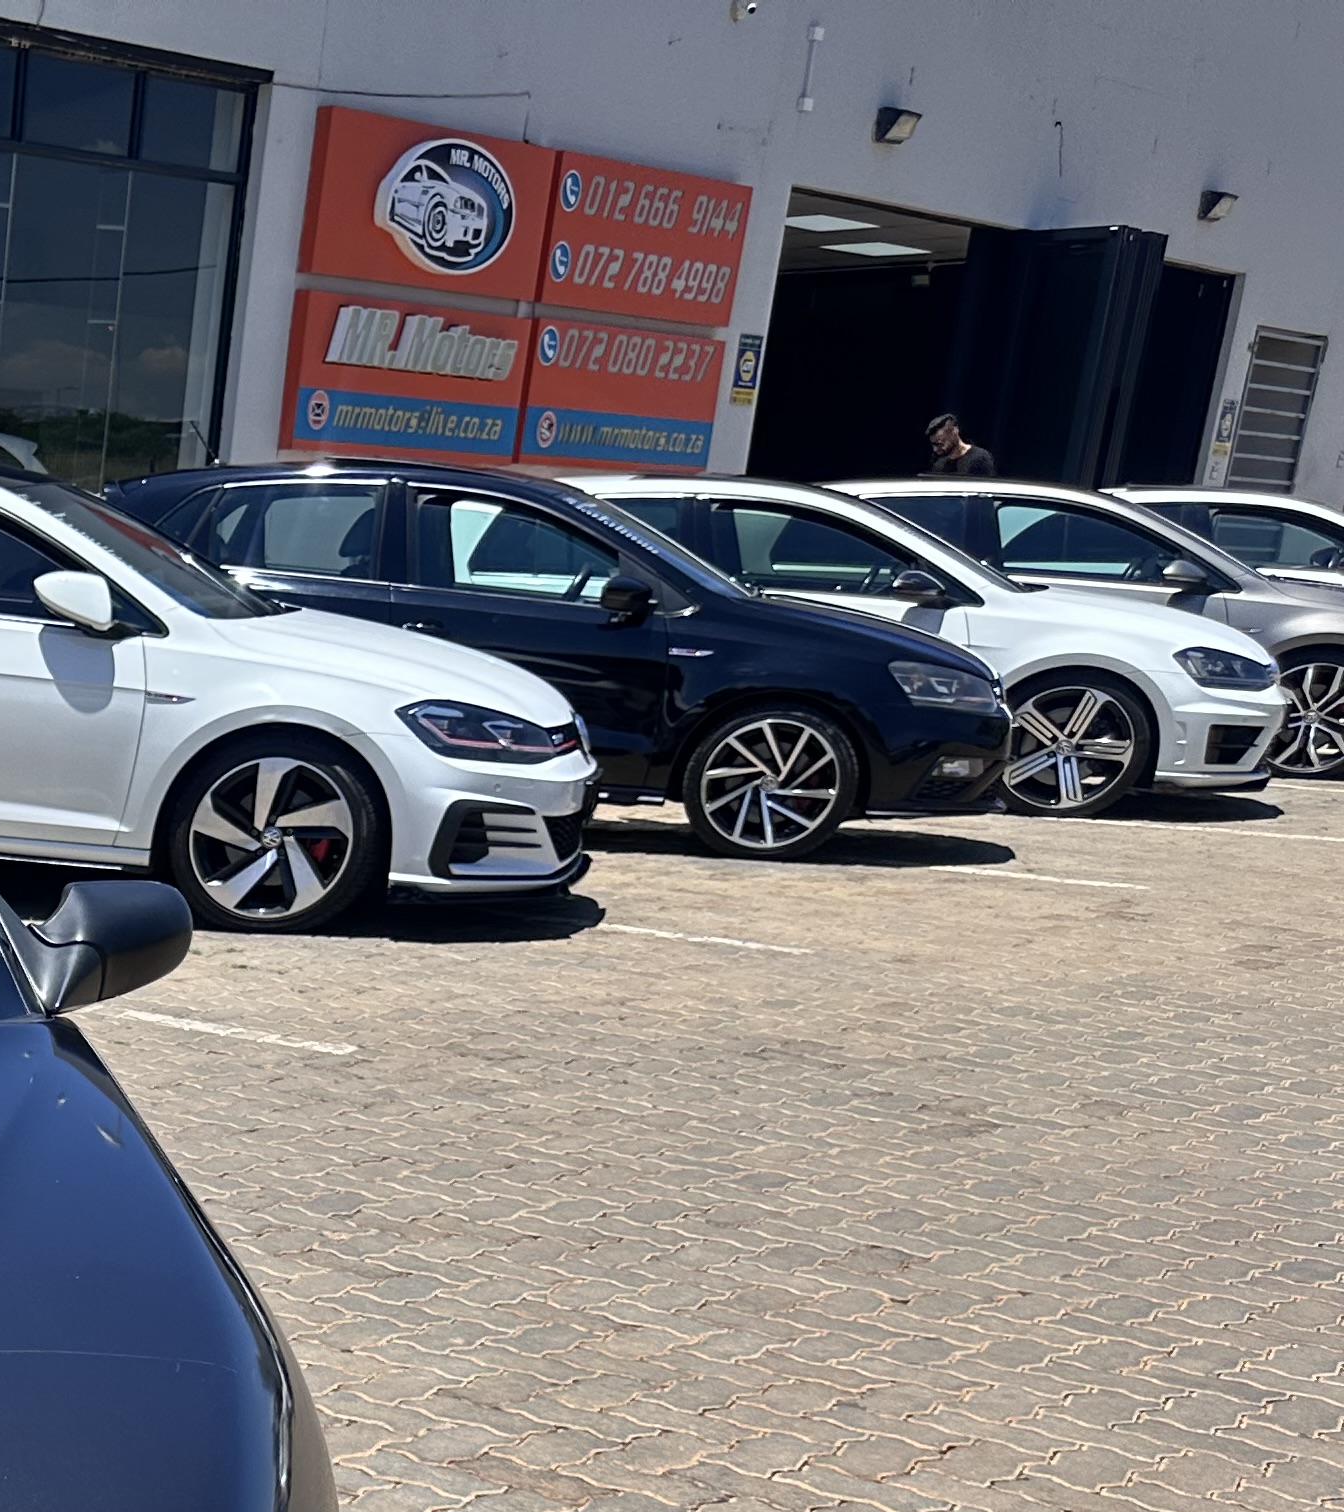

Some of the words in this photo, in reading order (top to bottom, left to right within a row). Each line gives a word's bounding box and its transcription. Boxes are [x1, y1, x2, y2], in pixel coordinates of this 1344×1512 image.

[473, 154, 510, 210] MOTORS
[583, 175, 635, 221] 012
[633, 184, 683, 229] 666
[688, 195, 743, 240] 9144
[573, 244, 624, 289] 072
[624, 252, 673, 296] 788
[671, 260, 731, 304] 4998
[399, 314, 518, 380] Motors
[559, 328, 609, 372] 072
[608, 334, 656, 377] 080
[655, 341, 716, 382] 2237
[558, 422, 704, 454] www.mrmotors.co.za
